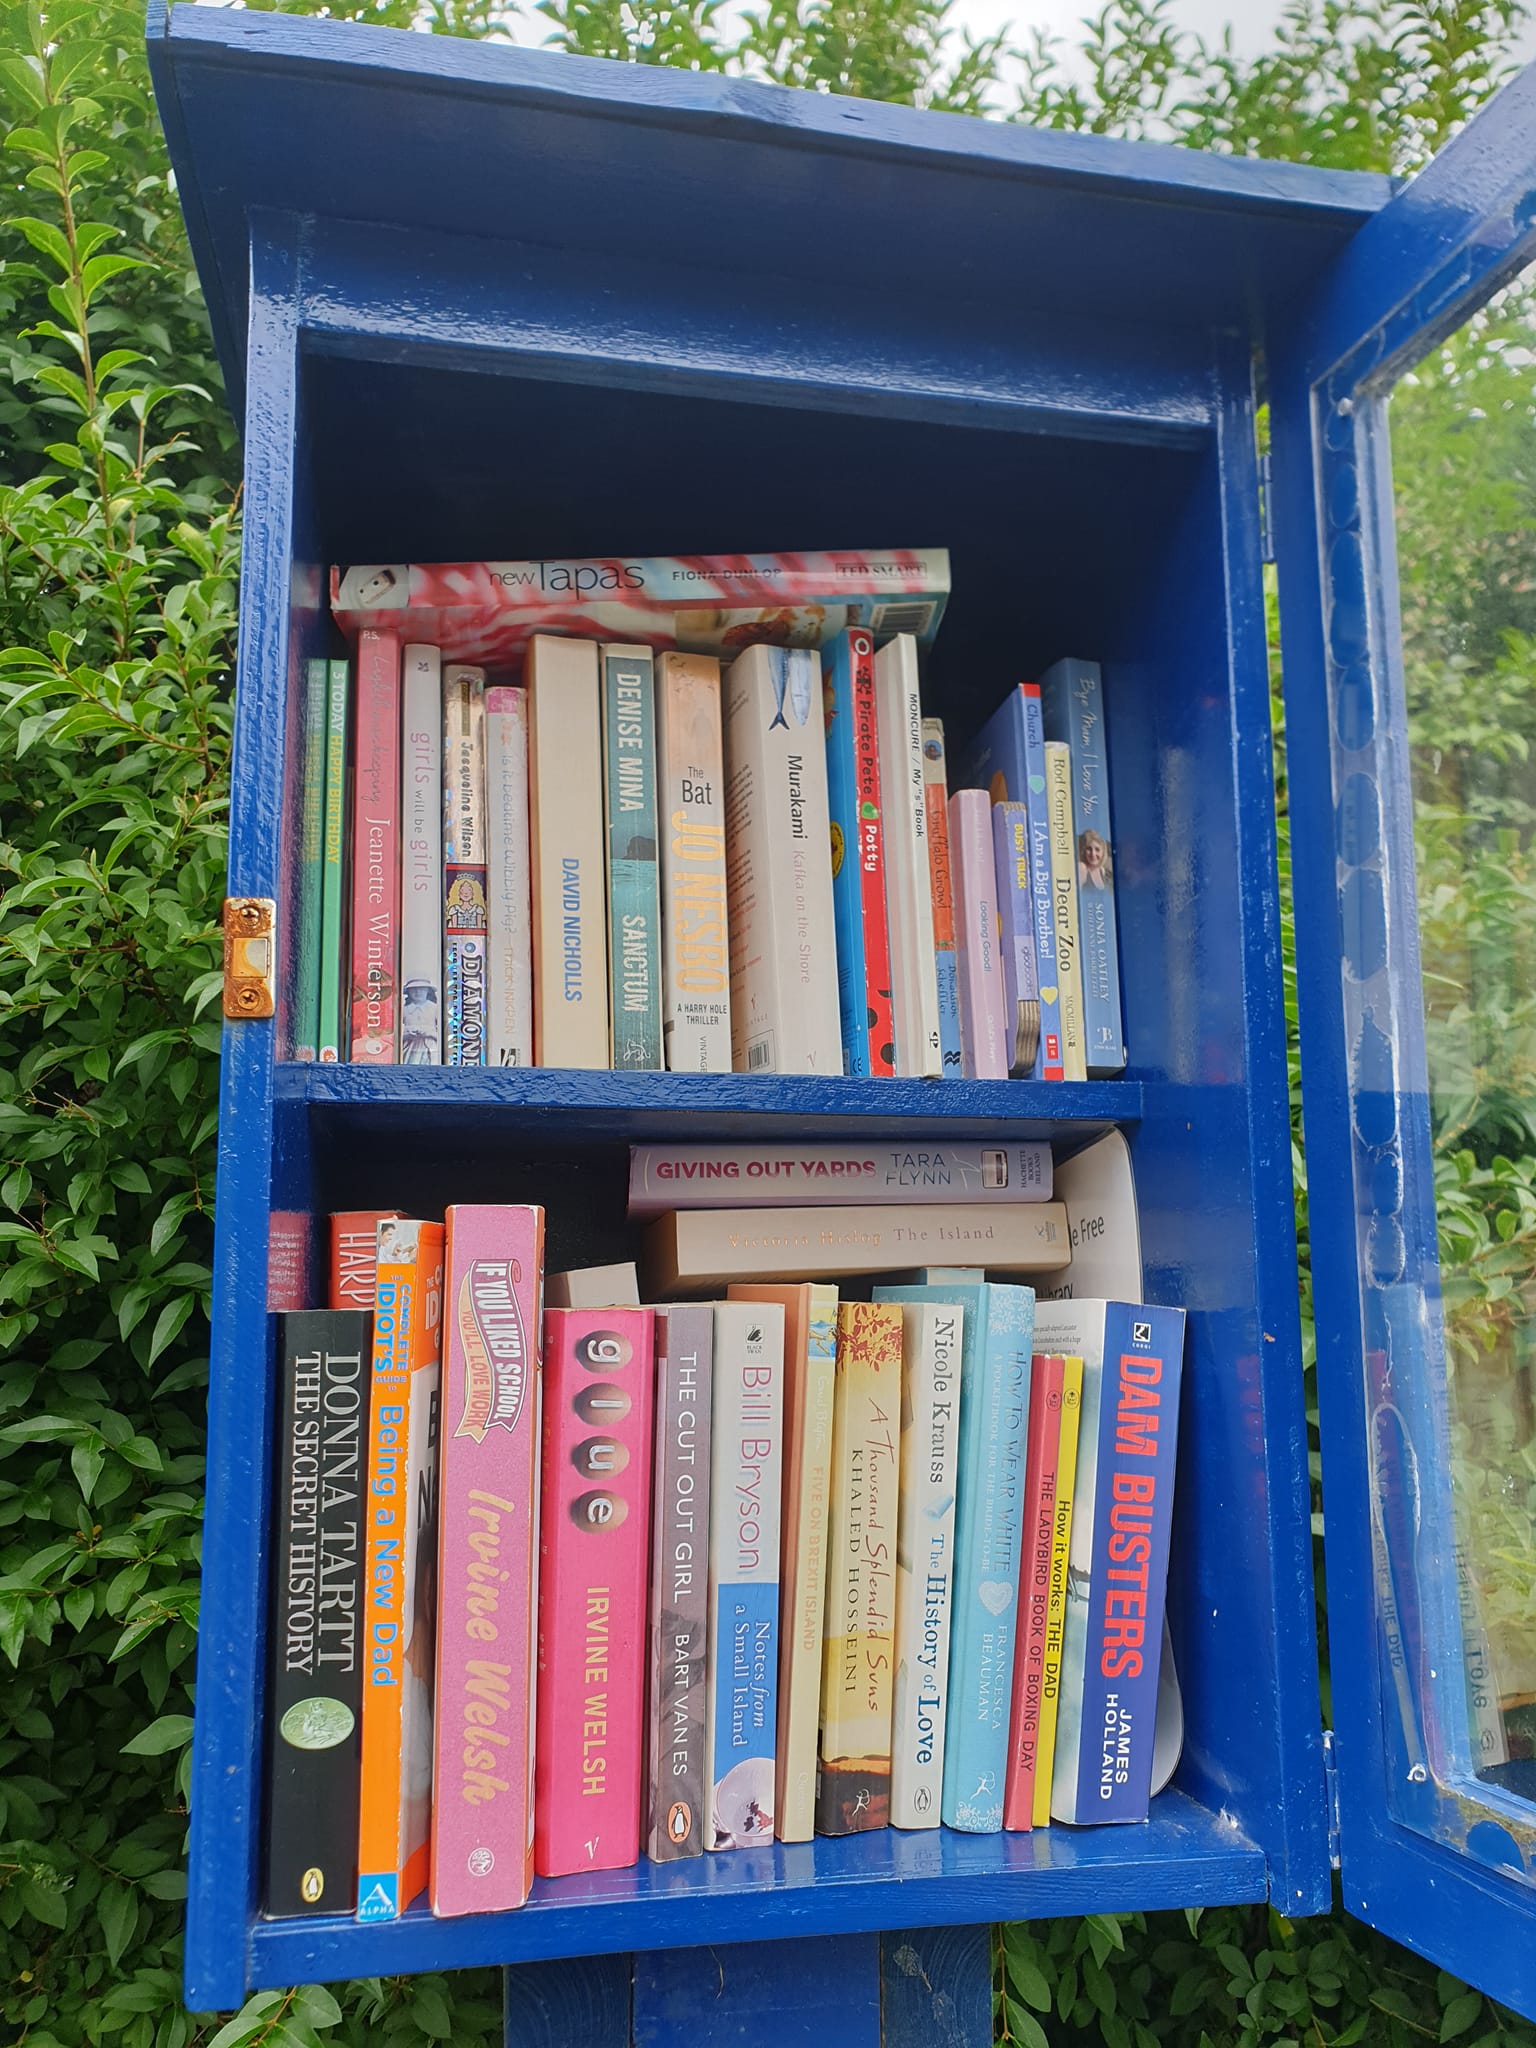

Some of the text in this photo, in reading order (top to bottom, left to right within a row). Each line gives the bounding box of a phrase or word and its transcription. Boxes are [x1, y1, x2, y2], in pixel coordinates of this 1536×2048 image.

[490, 561, 645, 601] new Tapas
[673, 568, 782, 581] FIONA DUNLOP
[872, 564, 925, 577] SMART
[363, 631, 381, 641] P.S.
[331, 682, 345, 732] TODAY
[1074, 677, 1096, 708] Bye
[328, 735, 343, 783] HAPPY
[459, 742, 473, 812] Jacqueline
[616, 673, 644, 812] DENISE MINA
[688, 766, 704, 779] The
[859, 700, 877, 872] Pirate Pete Potty
[909, 693, 924, 838] MONCURE My Book
[1082, 764, 1099, 791] Love
[326, 789, 343, 864] BIRTHDAY
[410, 732, 435, 892] girls will be girls
[503, 784, 515, 843] bedtime
[682, 779, 712, 805] Bat
[1053, 758, 1069, 856] Rod Campbell
[461, 817, 474, 858] Wilson
[788, 754, 811, 984] Murakami Kafka on the Shore
[1014, 823, 1027, 889] BUSY TRUCK
[1034, 830, 1049, 858] Am
[366, 816, 391, 1028] Jeanette Winterson
[671, 810, 729, 993] JO NESBO
[979, 901, 988, 937] Looking
[1035, 870, 1050, 896] Big
[1056, 877, 1074, 972] Dear Zoo
[562, 857, 583, 1002] DAVID NICHOLLS
[622, 914, 649, 1012] SANCTUM
[1036, 899, 1055, 959] Brother!
[1094, 903, 1109, 1002] SONIA OATLEY
[677, 1003, 727, 1014] A HARRY HOLE
[686, 1015, 719, 1025] THRILLER
[1064, 995, 1075, 1039] MACMILLAN
[656, 1160, 877, 1179] GIVING OUT YARDS
[886, 1170, 951, 1186] FLYNN
[890, 1153, 946, 1168] TARA
[893, 1225, 994, 1241] The Island
[1081, 1215, 1105, 1244] Free
[375, 1282, 396, 1372] IDIOT'S
[396, 1283, 411, 1371] COMPLETE
[474, 1355, 490, 1387] LOVE
[475, 1262, 522, 1420] IF YOU LIKED SCHOOL
[464, 1386, 490, 1429] WORK
[930, 1317, 954, 1483] Nicole Krauss
[736, 1366, 772, 1570] Bill Bryson
[994, 1350, 1027, 1573] HOW TO WEAR WHITE
[286, 1351, 321, 1676] THE SECRET HISTORY
[317, 1351, 360, 1673] DONNA TARTT
[372, 1405, 403, 1687] Being a New Dad
[861, 1397, 895, 1712] A Thousand Splendid Suns
[1101, 1353, 1163, 1679] DAM BUSTERS
[673, 1351, 697, 1776] THE CUT OUT GIRL BART VAN ES
[803, 1466, 823, 1651] FIVE ON BREXIT ISLAND
[845, 1449, 863, 1693] KHALED HOSSEINI
[1044, 1499, 1070, 1700] How it works: THE DAD
[462, 1488, 515, 1806] Irvine Welsh
[916, 1533, 947, 1764] The History of Love
[1020, 1472, 1055, 1772] THE LADYBIRD BOOK OF BOXING DAY
[582, 1586, 610, 1796] IRVINE WELSH
[732, 1604, 750, 1747] a Small Island
[750, 1621, 771, 1728] Notes from
[978, 1633, 993, 1721] BEAUMAN
[992, 1625, 1008, 1729] FRANCESCA
[1099, 1693, 1119, 1800] HOLLAND
[1116, 1708, 1133, 1784] JAMES
[360, 1905, 395, 1916] ALPHA
